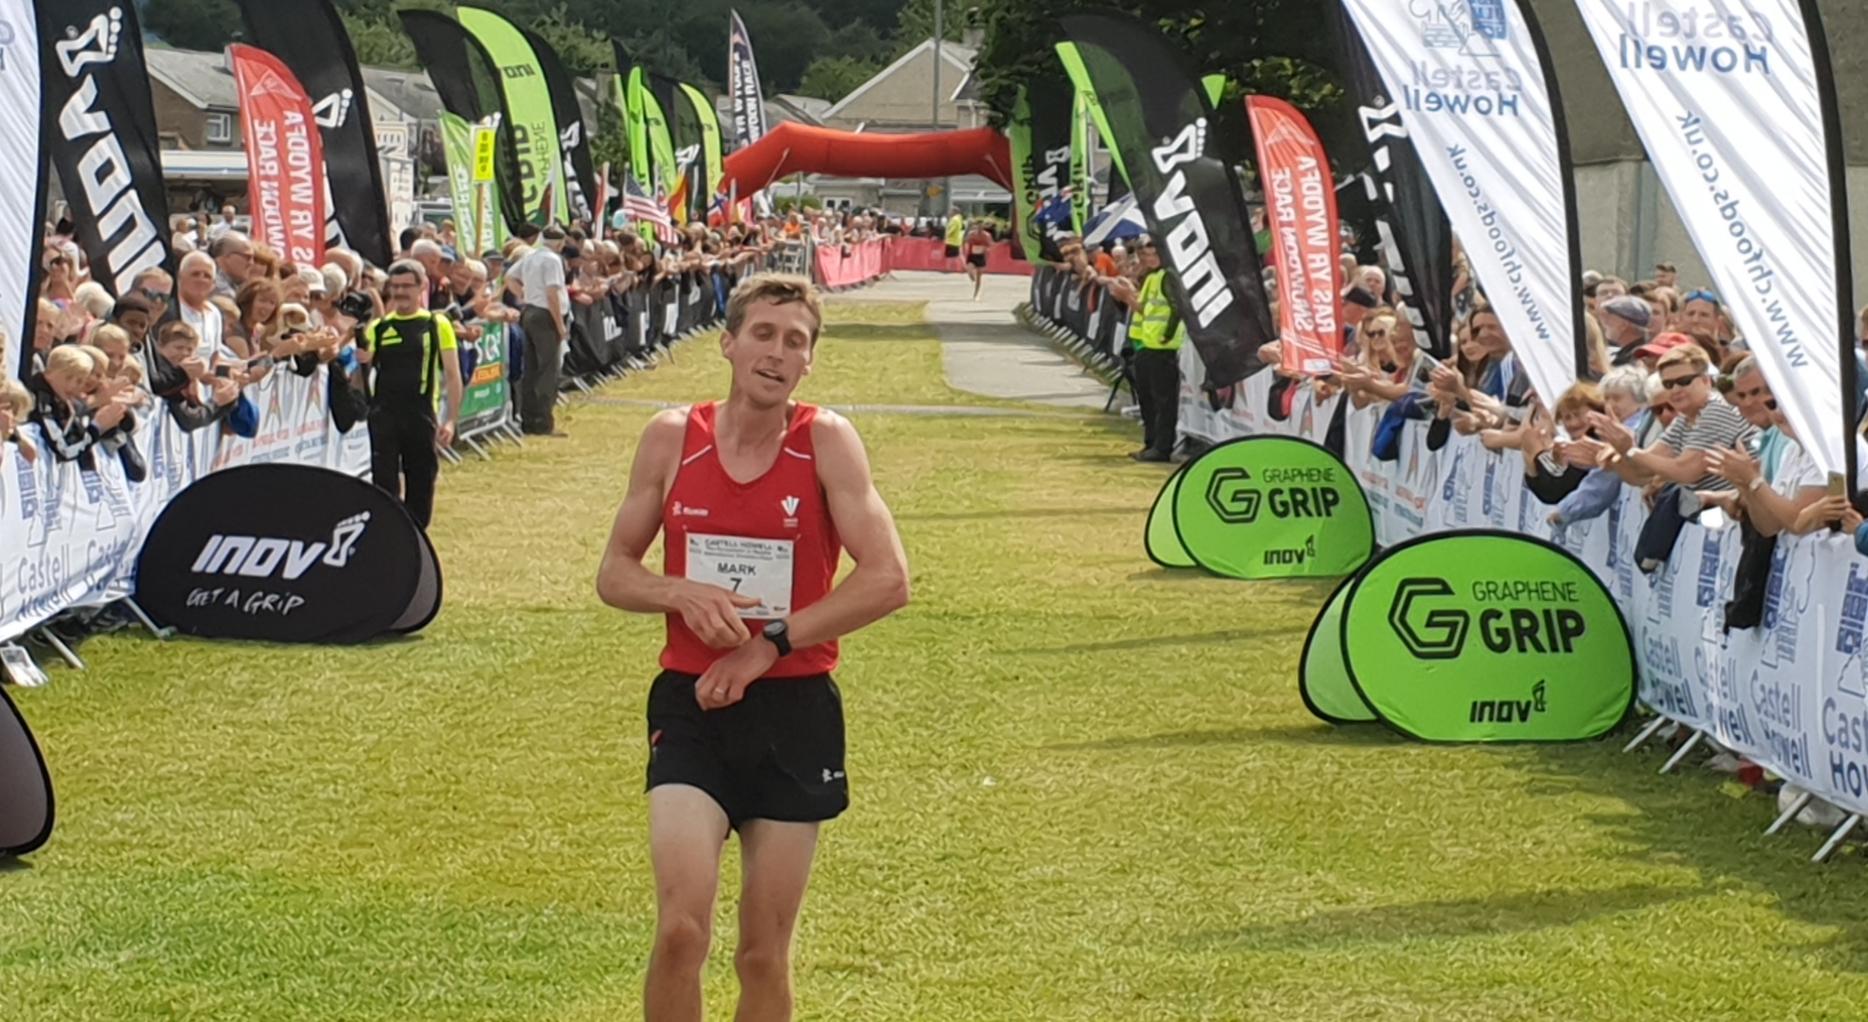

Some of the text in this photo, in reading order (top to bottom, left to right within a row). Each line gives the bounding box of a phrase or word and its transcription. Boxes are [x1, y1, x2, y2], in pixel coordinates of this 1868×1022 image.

[1262, 467, 1336, 483] GRAPHENE
[1268, 487, 1340, 518] GRIP
[18, 543, 71, 594] Castell
[717, 562, 756, 576] MARK
[730, 577, 742, 592] 7
[1471, 581, 1578, 601] GRAPHENE
[186, 588, 224, 607] GET
[224, 589, 240, 607] A
[1479, 608, 1585, 654] GRIP
